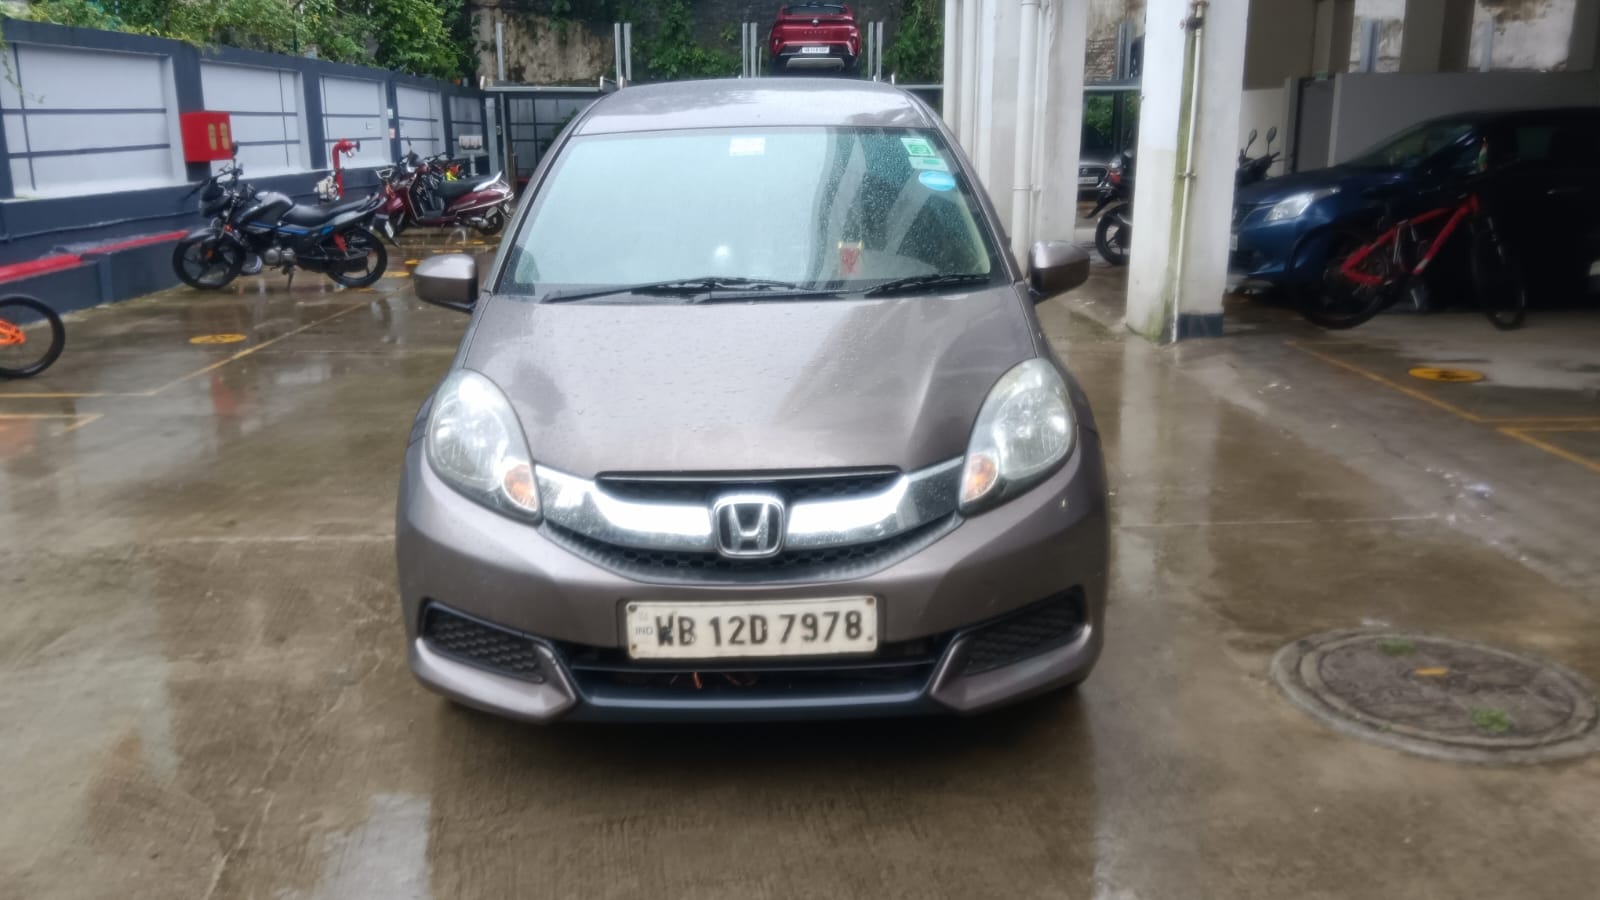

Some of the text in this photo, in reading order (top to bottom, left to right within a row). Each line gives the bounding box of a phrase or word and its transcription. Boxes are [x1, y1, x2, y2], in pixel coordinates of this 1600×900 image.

[635, 626, 654, 635] IND
[656, 610, 863, 646] WB 12D 7978
